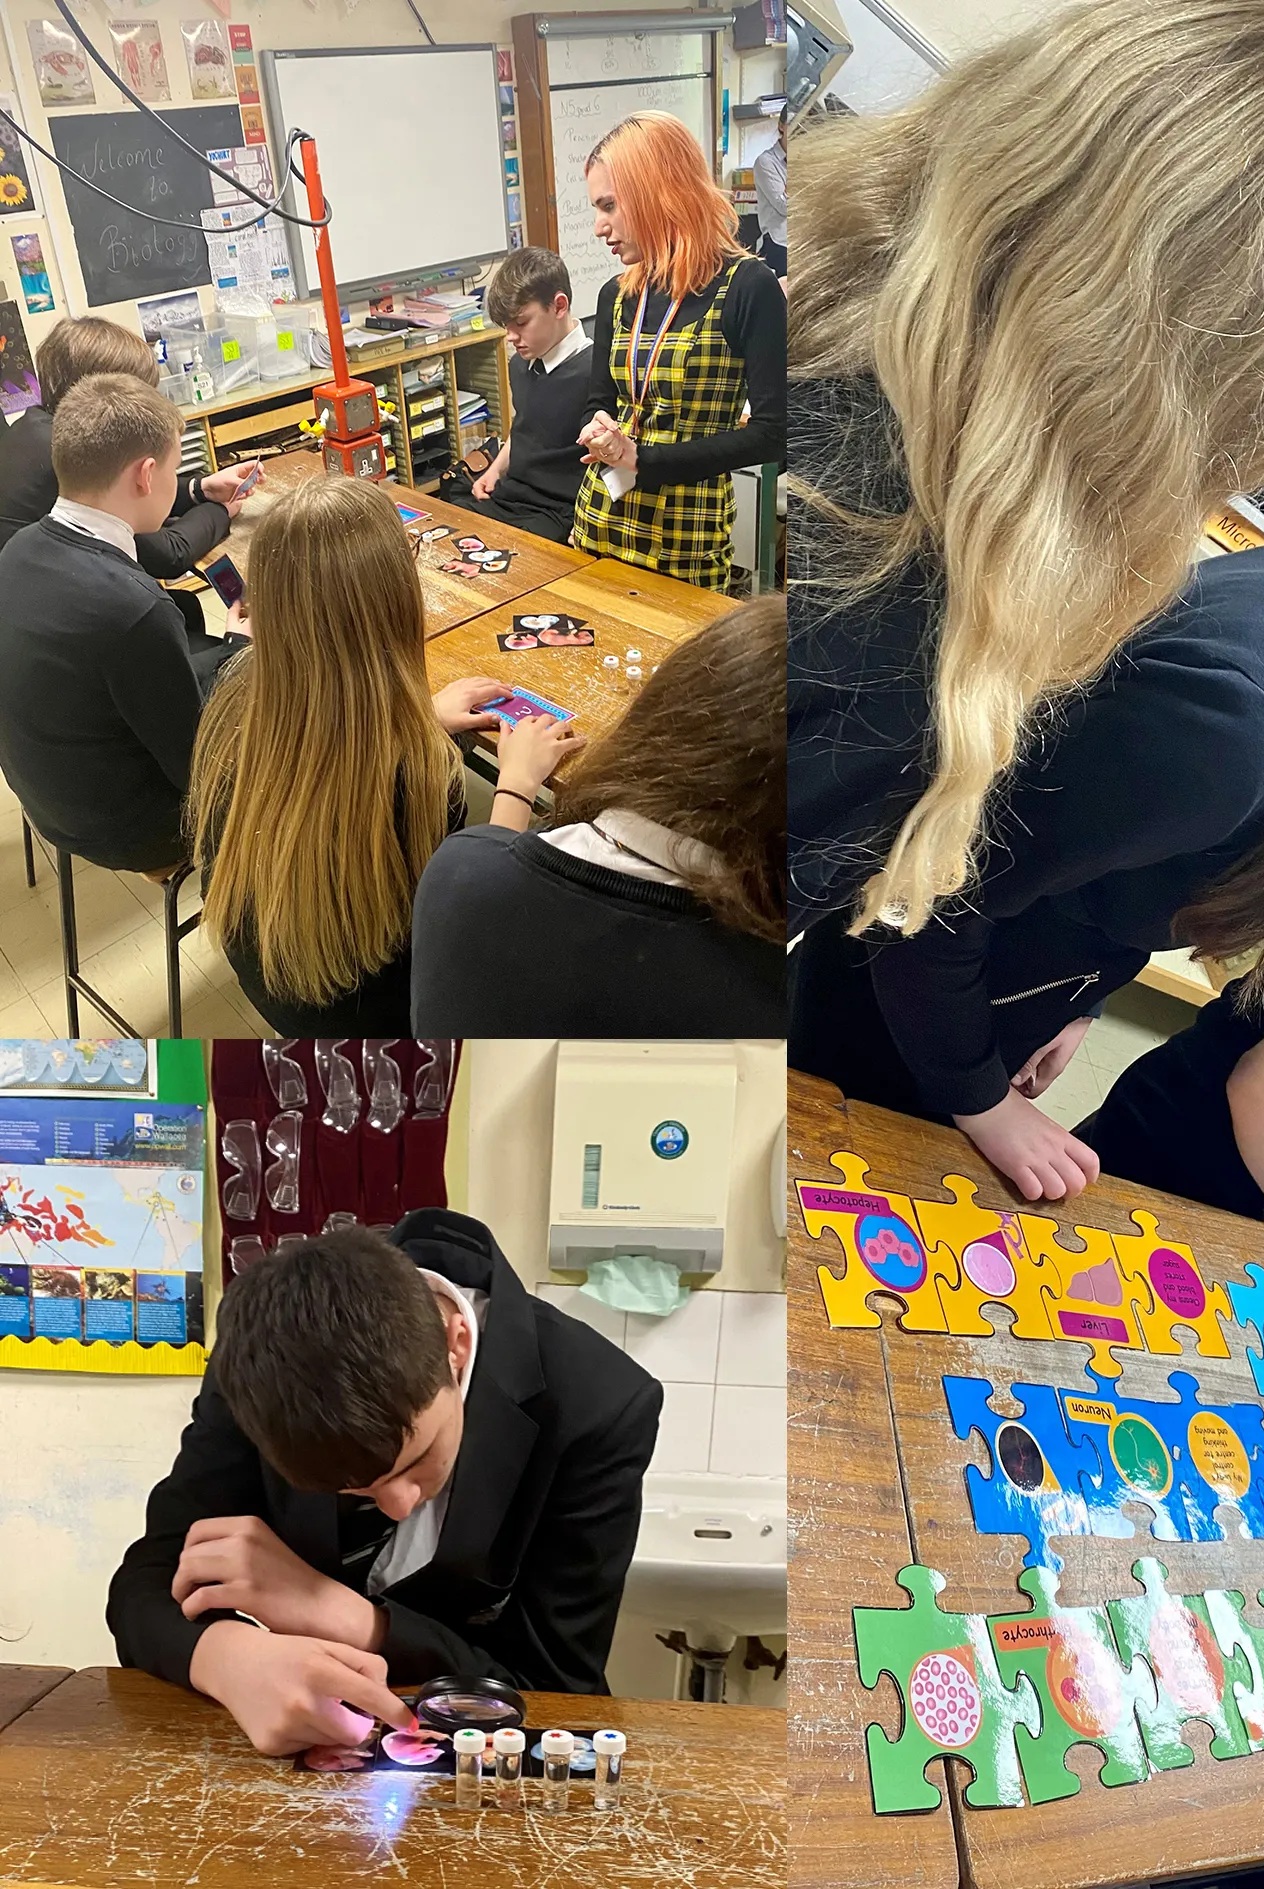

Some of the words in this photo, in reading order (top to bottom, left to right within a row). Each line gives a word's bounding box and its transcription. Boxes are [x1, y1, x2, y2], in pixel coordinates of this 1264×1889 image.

[66, 138, 166, 181] Welcome
[99, 224, 203, 282] Biology
[814, 1192, 880, 1212] Hepatocyte
[1081, 1319, 1111, 1335] Liver
[1071, 1402, 1112, 1420] Neuron
[1194, 1425, 1216, 1435] moving
[1216, 1428, 1229, 1436] and
[1203, 1437, 1228, 1447] thinking
[1203, 1451, 1214, 1459] for
[1215, 1451, 1235, 1459] centre
[1212, 1462, 1234, 1471] control
